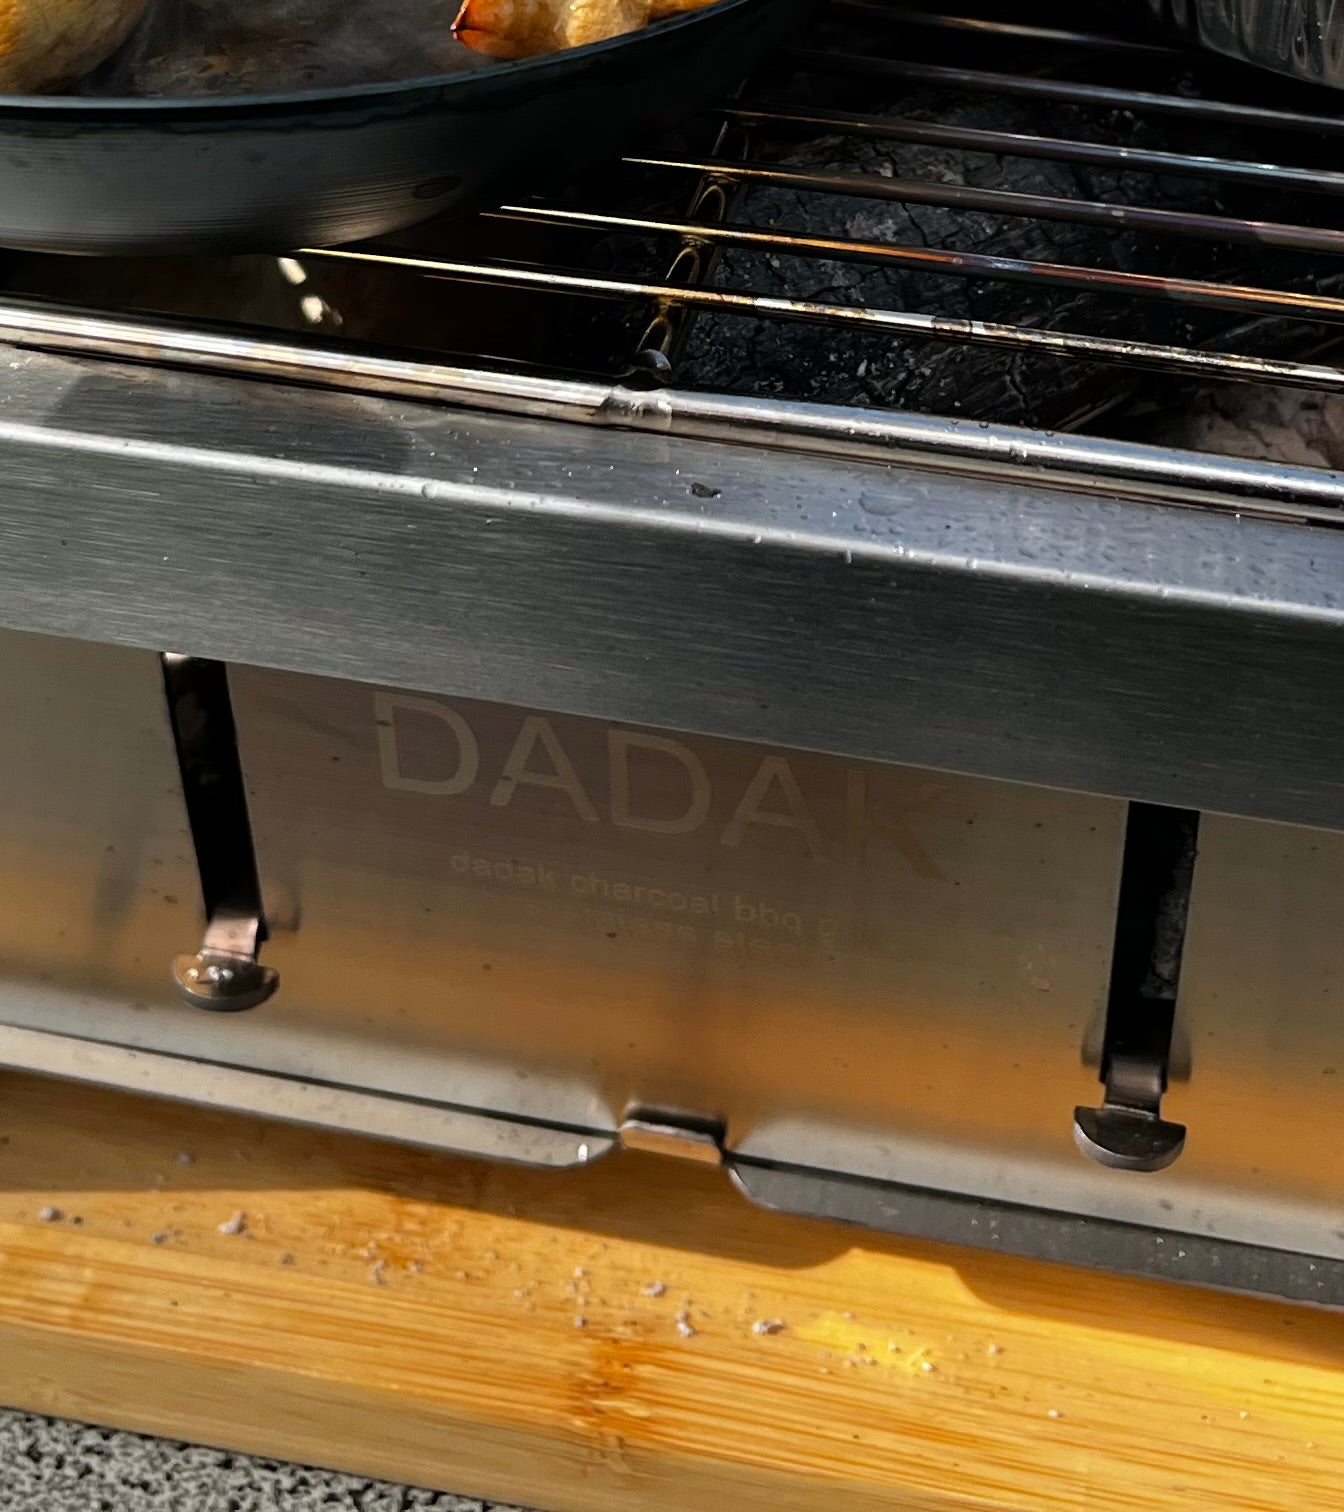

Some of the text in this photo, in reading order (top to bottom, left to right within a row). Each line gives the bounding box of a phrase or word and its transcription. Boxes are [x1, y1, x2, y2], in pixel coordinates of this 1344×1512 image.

[374, 691, 948, 880] DADAK
[569, 870, 721, 916] charcoal
[733, 894, 804, 939] bbq
